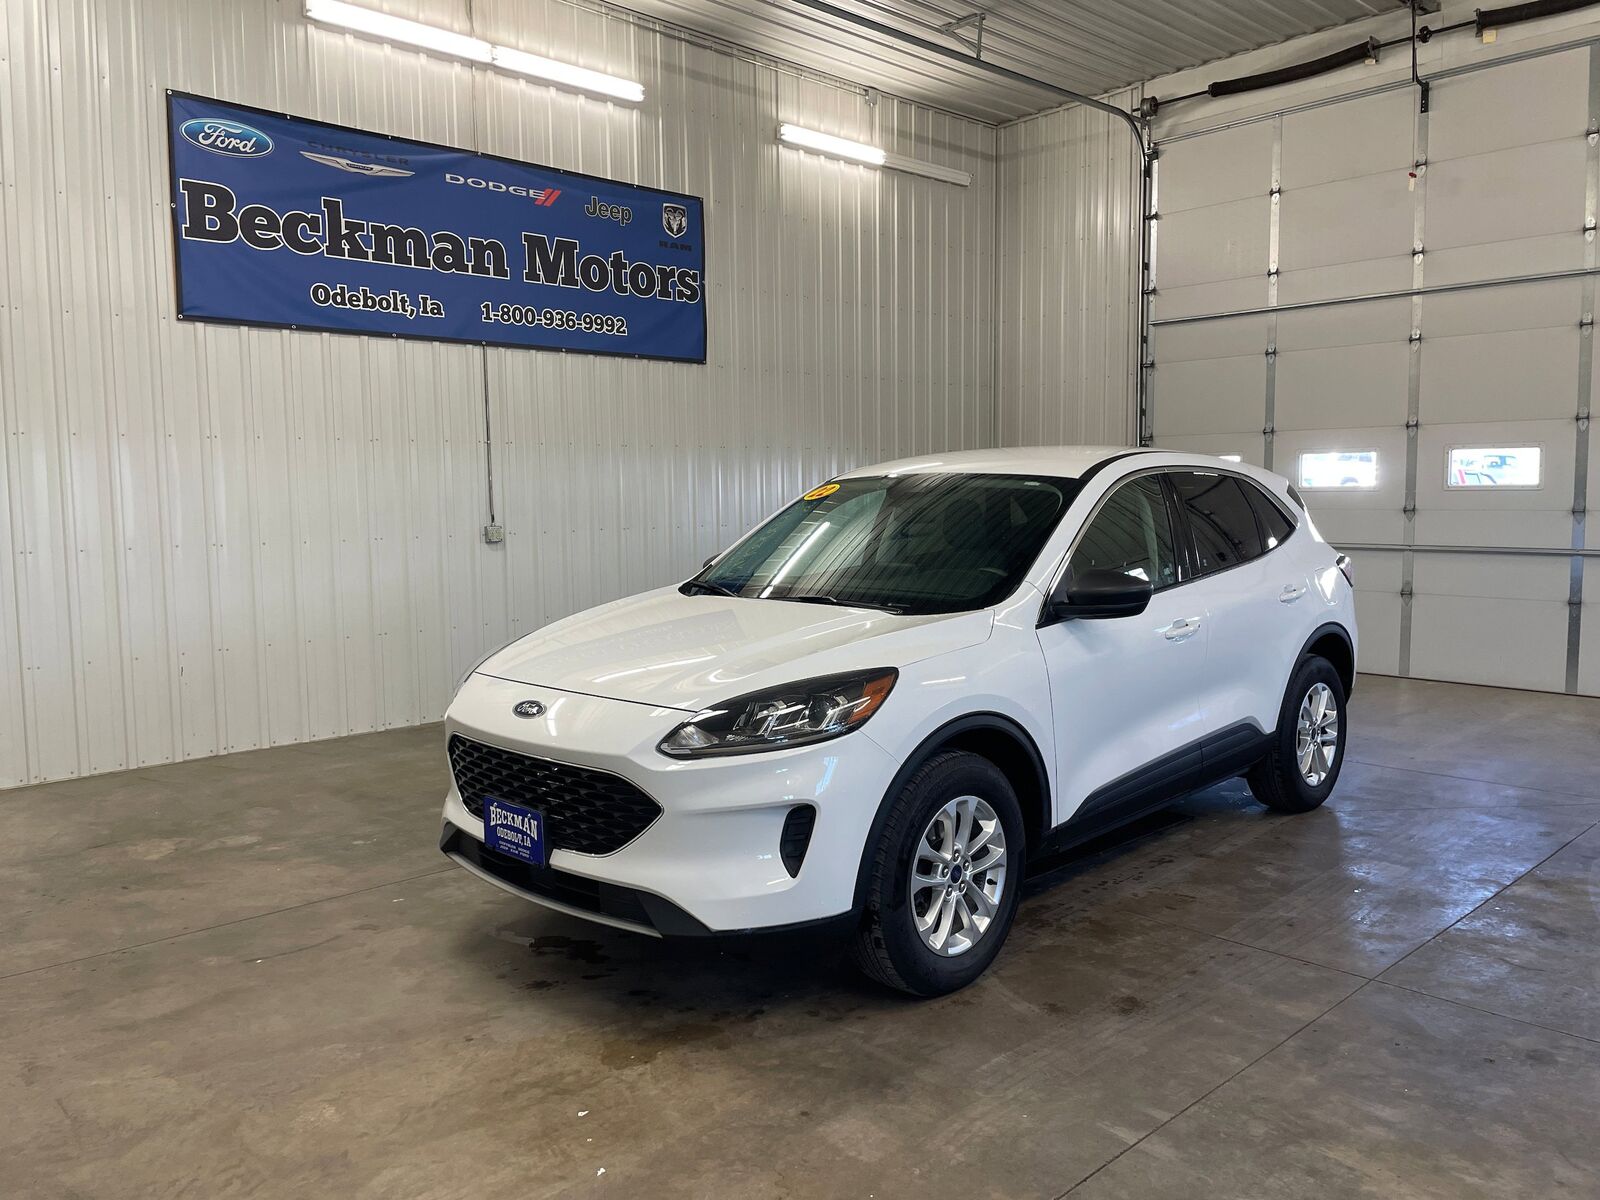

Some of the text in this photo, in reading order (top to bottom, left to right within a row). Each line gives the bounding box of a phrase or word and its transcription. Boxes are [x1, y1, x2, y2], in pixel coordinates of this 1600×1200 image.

[198, 122, 256, 154] Ford
[445, 173, 546, 200] DODGE
[584, 195, 633, 227] Jeep
[179, 177, 700, 304] Beckman Motors
[658, 239, 692, 252] RAM
[310, 282, 445, 320] Odebolt, Ia
[480, 301, 628, 336] 1-800-936-9992
[489, 804, 538, 841] BECKMAN
